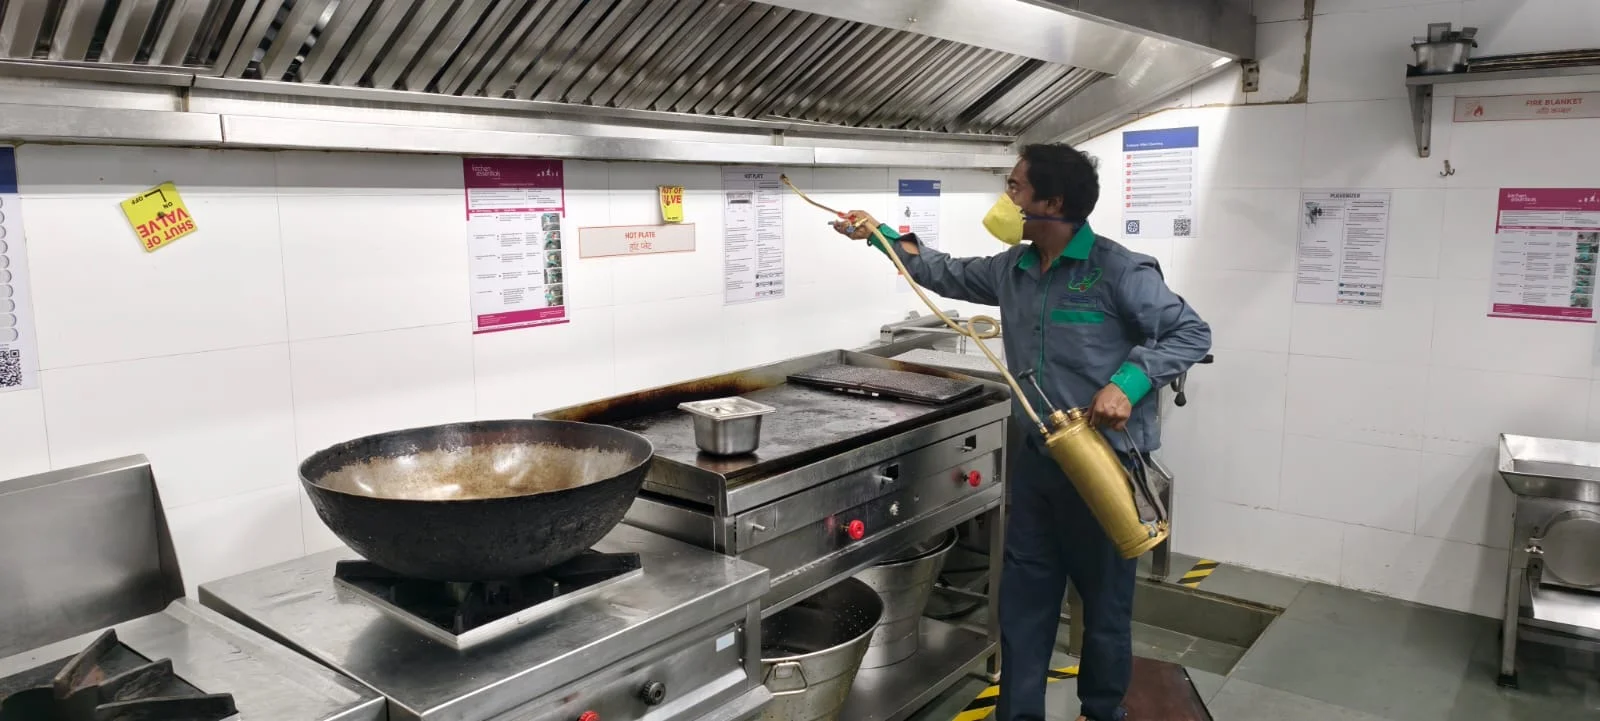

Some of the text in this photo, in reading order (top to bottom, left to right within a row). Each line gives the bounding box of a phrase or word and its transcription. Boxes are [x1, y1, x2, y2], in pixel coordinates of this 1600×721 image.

[1545, 97, 1583, 106] BLANKET
[131, 196, 144, 205] OFF
[163, 201, 173, 209] ON
[136, 207, 190, 239] VALVE
[146, 220, 194, 249] SHUT OF
[638, 231, 656, 239] PLATE
